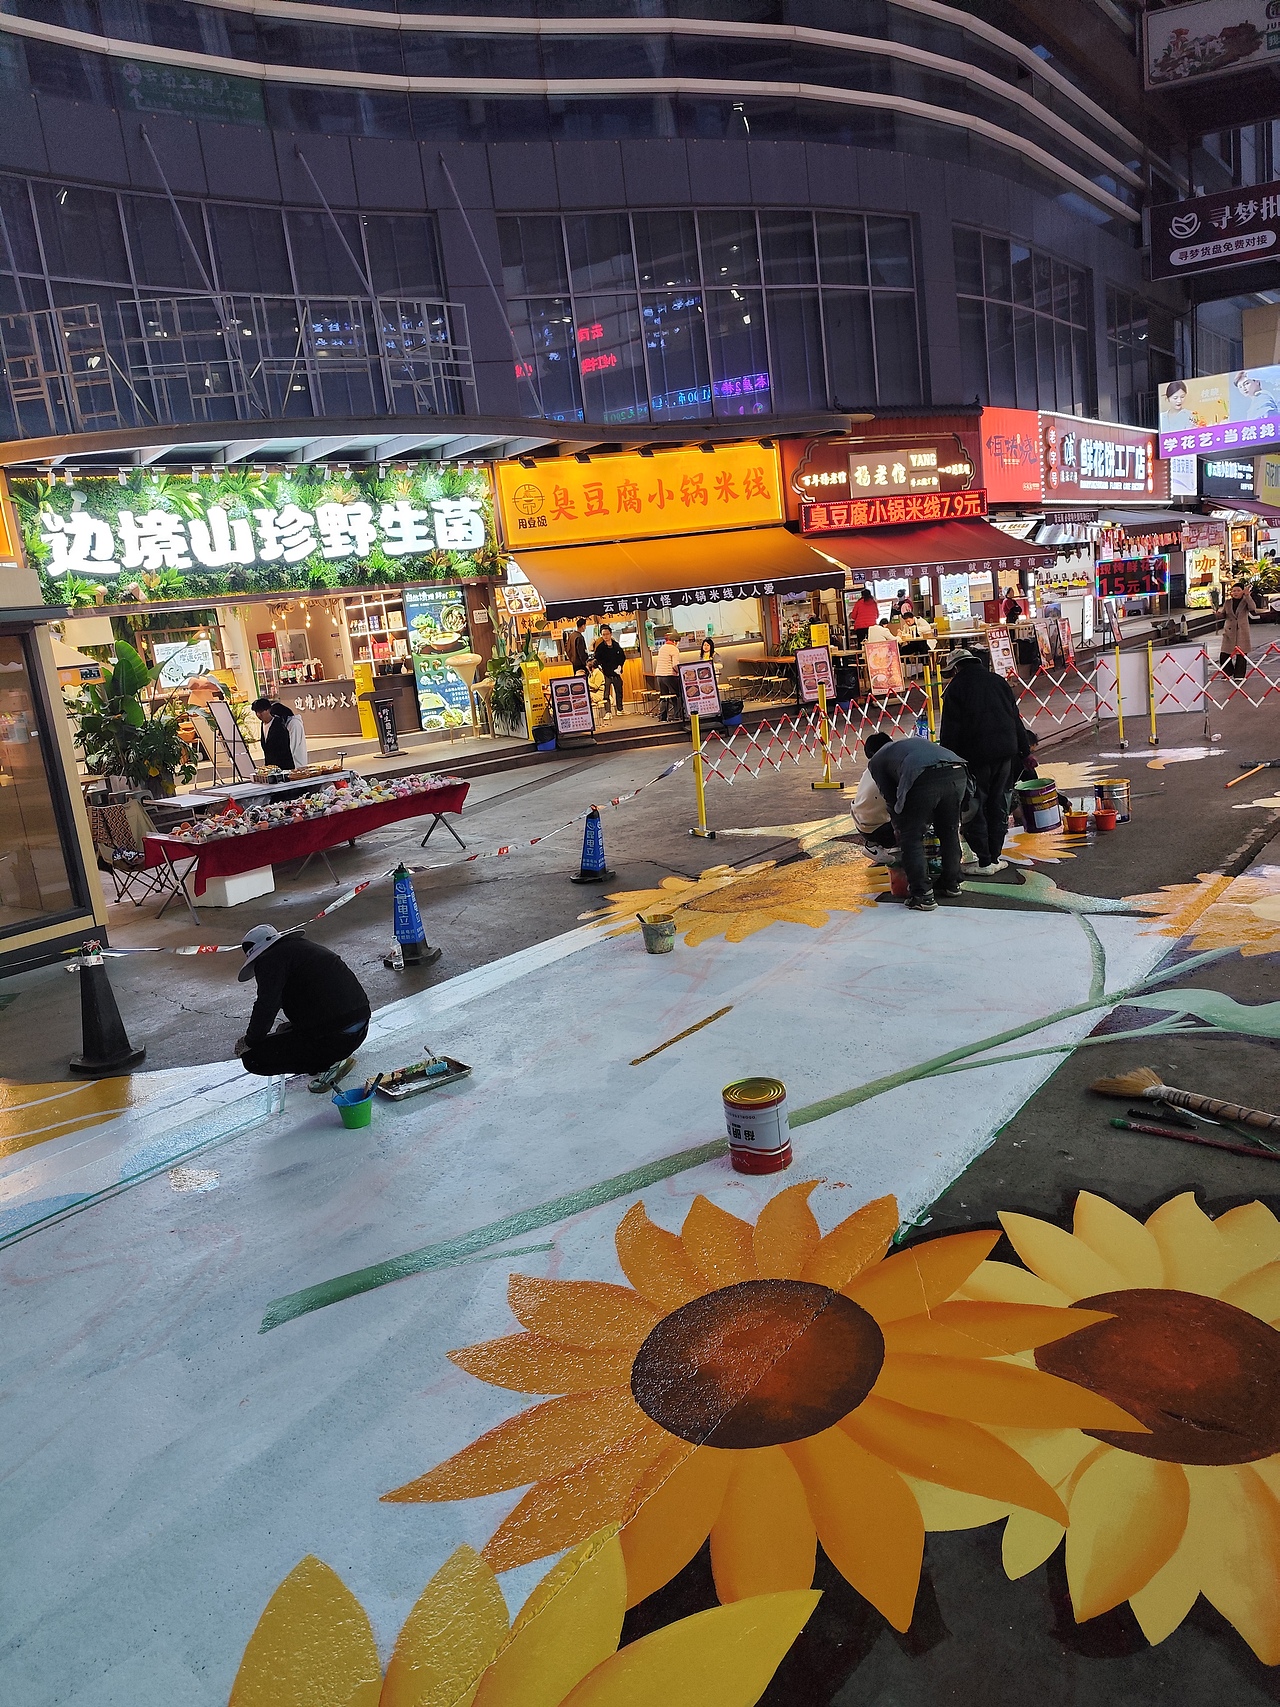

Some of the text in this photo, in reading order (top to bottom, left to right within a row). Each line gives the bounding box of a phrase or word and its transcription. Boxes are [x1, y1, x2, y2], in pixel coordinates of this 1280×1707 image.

[1178, 235, 1268, 261] 寻梦货盘免费对接
[910, 453, 937, 466] YANG
[1049, 429, 1058, 486] 老字号
[1080, 437, 1146, 480] 鲜花饼工厂店
[549, 466, 771, 521] 臭豆腐小锅米线
[809, 493, 981, 530] 臭豆腐小锅米线7.9元
[41, 497, 485, 577] 边境山珍野生菌
[603, 593, 672, 613] 云南十八怪
[681, 582, 775, 604] 小锅米线人人爱
